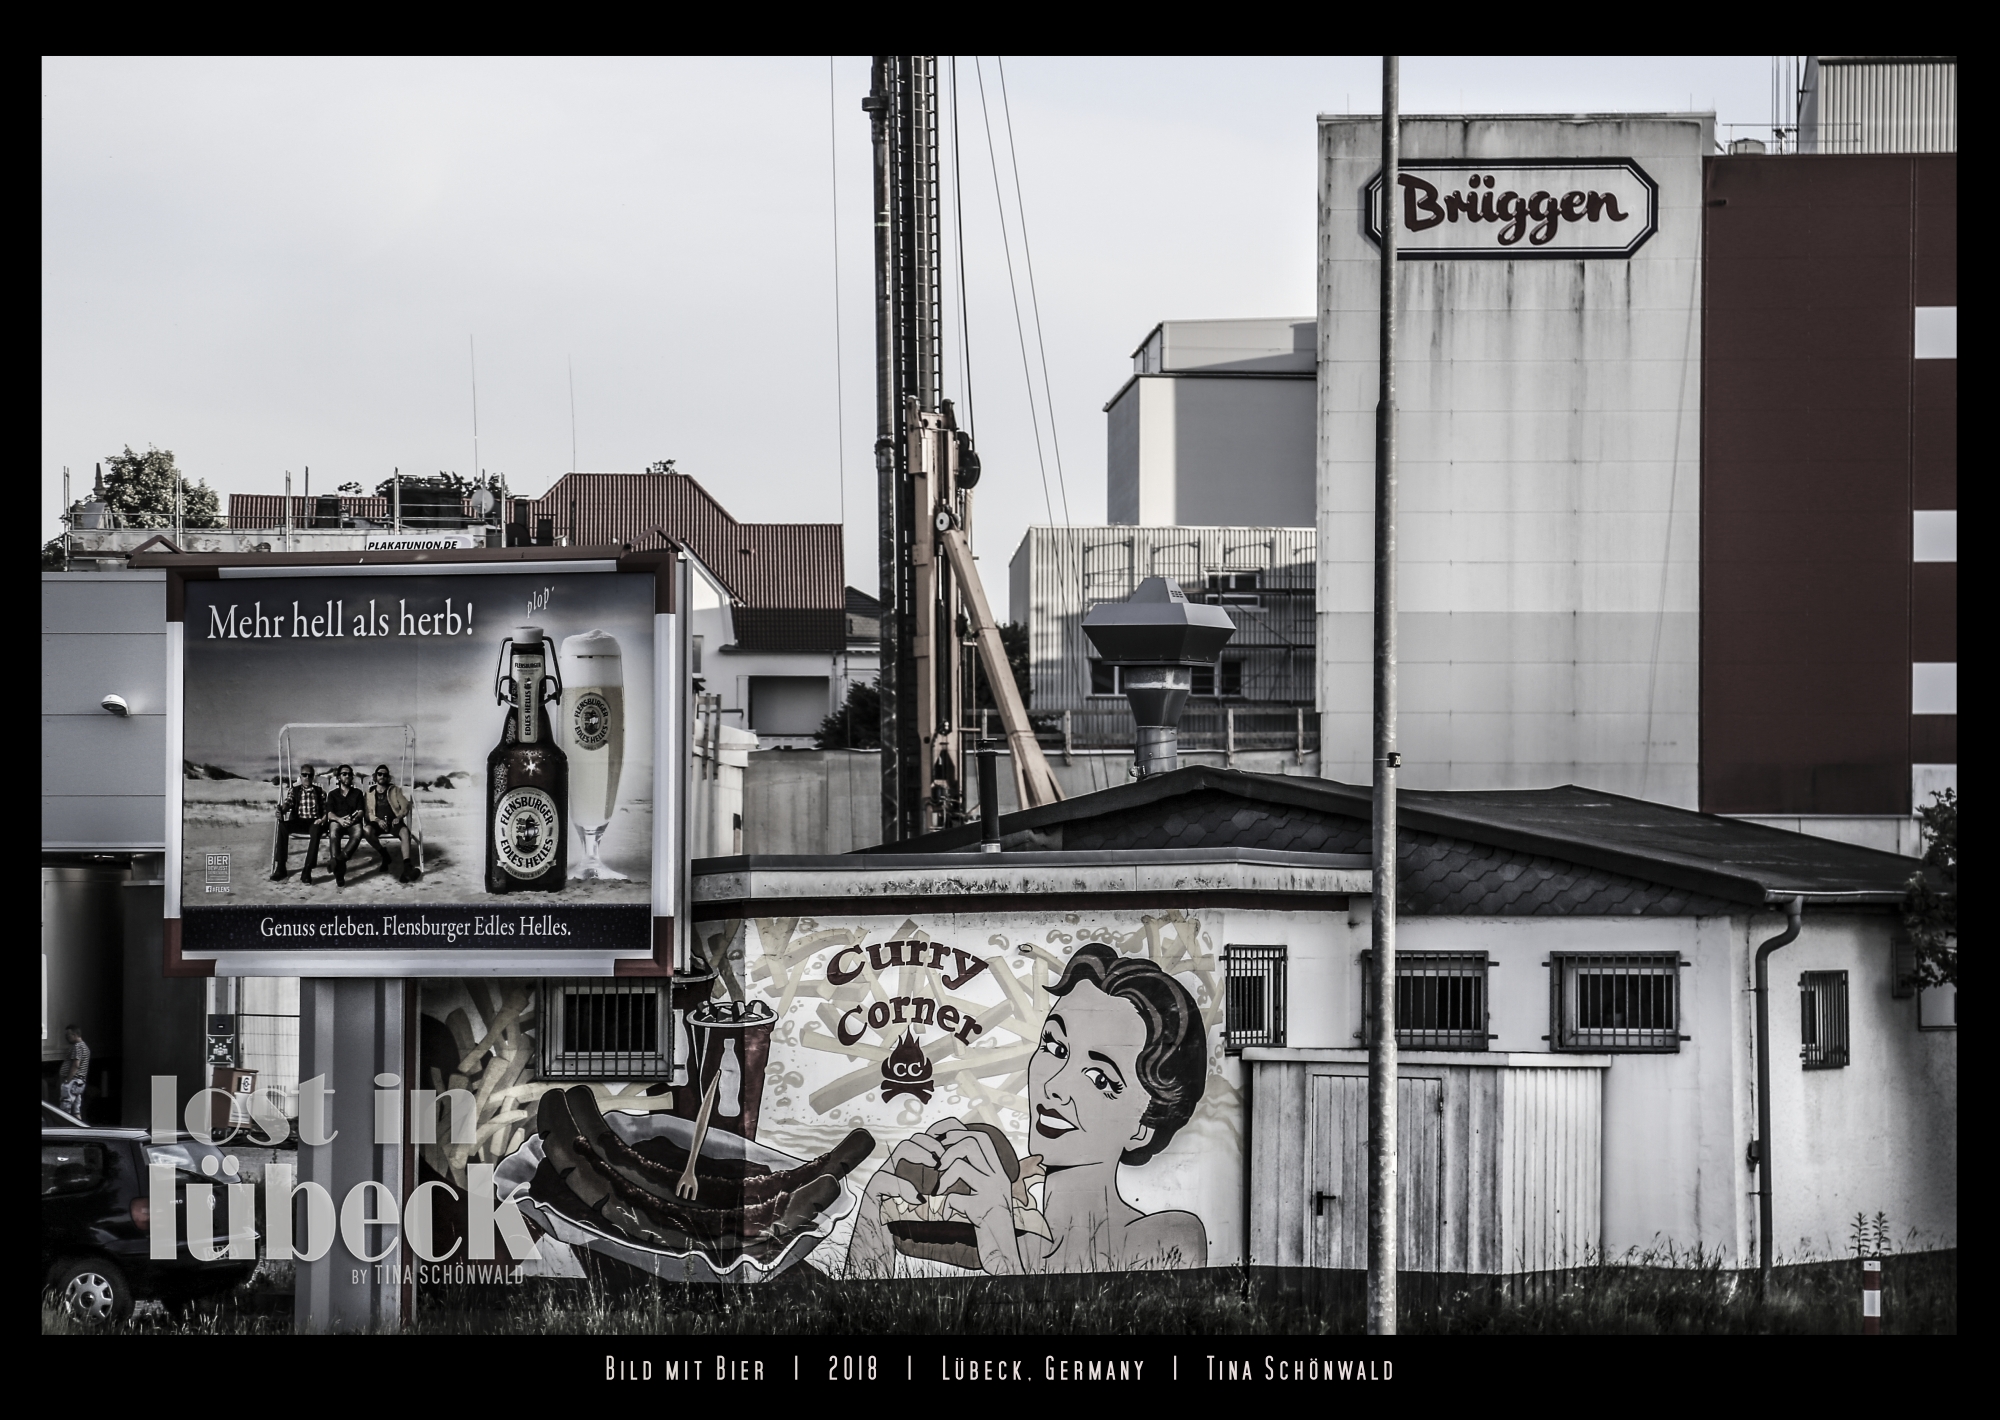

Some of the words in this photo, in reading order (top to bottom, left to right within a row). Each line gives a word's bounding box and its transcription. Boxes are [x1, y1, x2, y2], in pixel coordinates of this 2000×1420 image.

[1397, 173, 1629, 246] Brüggen
[368, 540, 458, 550] PLAKATUNION.DE
[207, 601, 285, 639] Mehr
[291, 599, 344, 638] hell
[353, 599, 389, 637] als
[398, 597, 473, 636] herb!
[574, 698, 609, 718] FLENSBURGER
[500, 796, 554, 826] FLENSBURGER
[207, 855, 229, 865] BIER
[500, 839, 524, 868] EDLES
[525, 838, 554, 869] HELLES
[260, 916, 315, 937] Genuss
[319, 915, 379, 936] erleben.
[382, 914, 471, 943] Flensburger
[473, 915, 515, 936] Edles
[519, 915, 572, 936] Helles.
[826, 940, 989, 990] Curry
[837, 996, 983, 1046] Corner
[893, 1061, 924, 1077] CC
